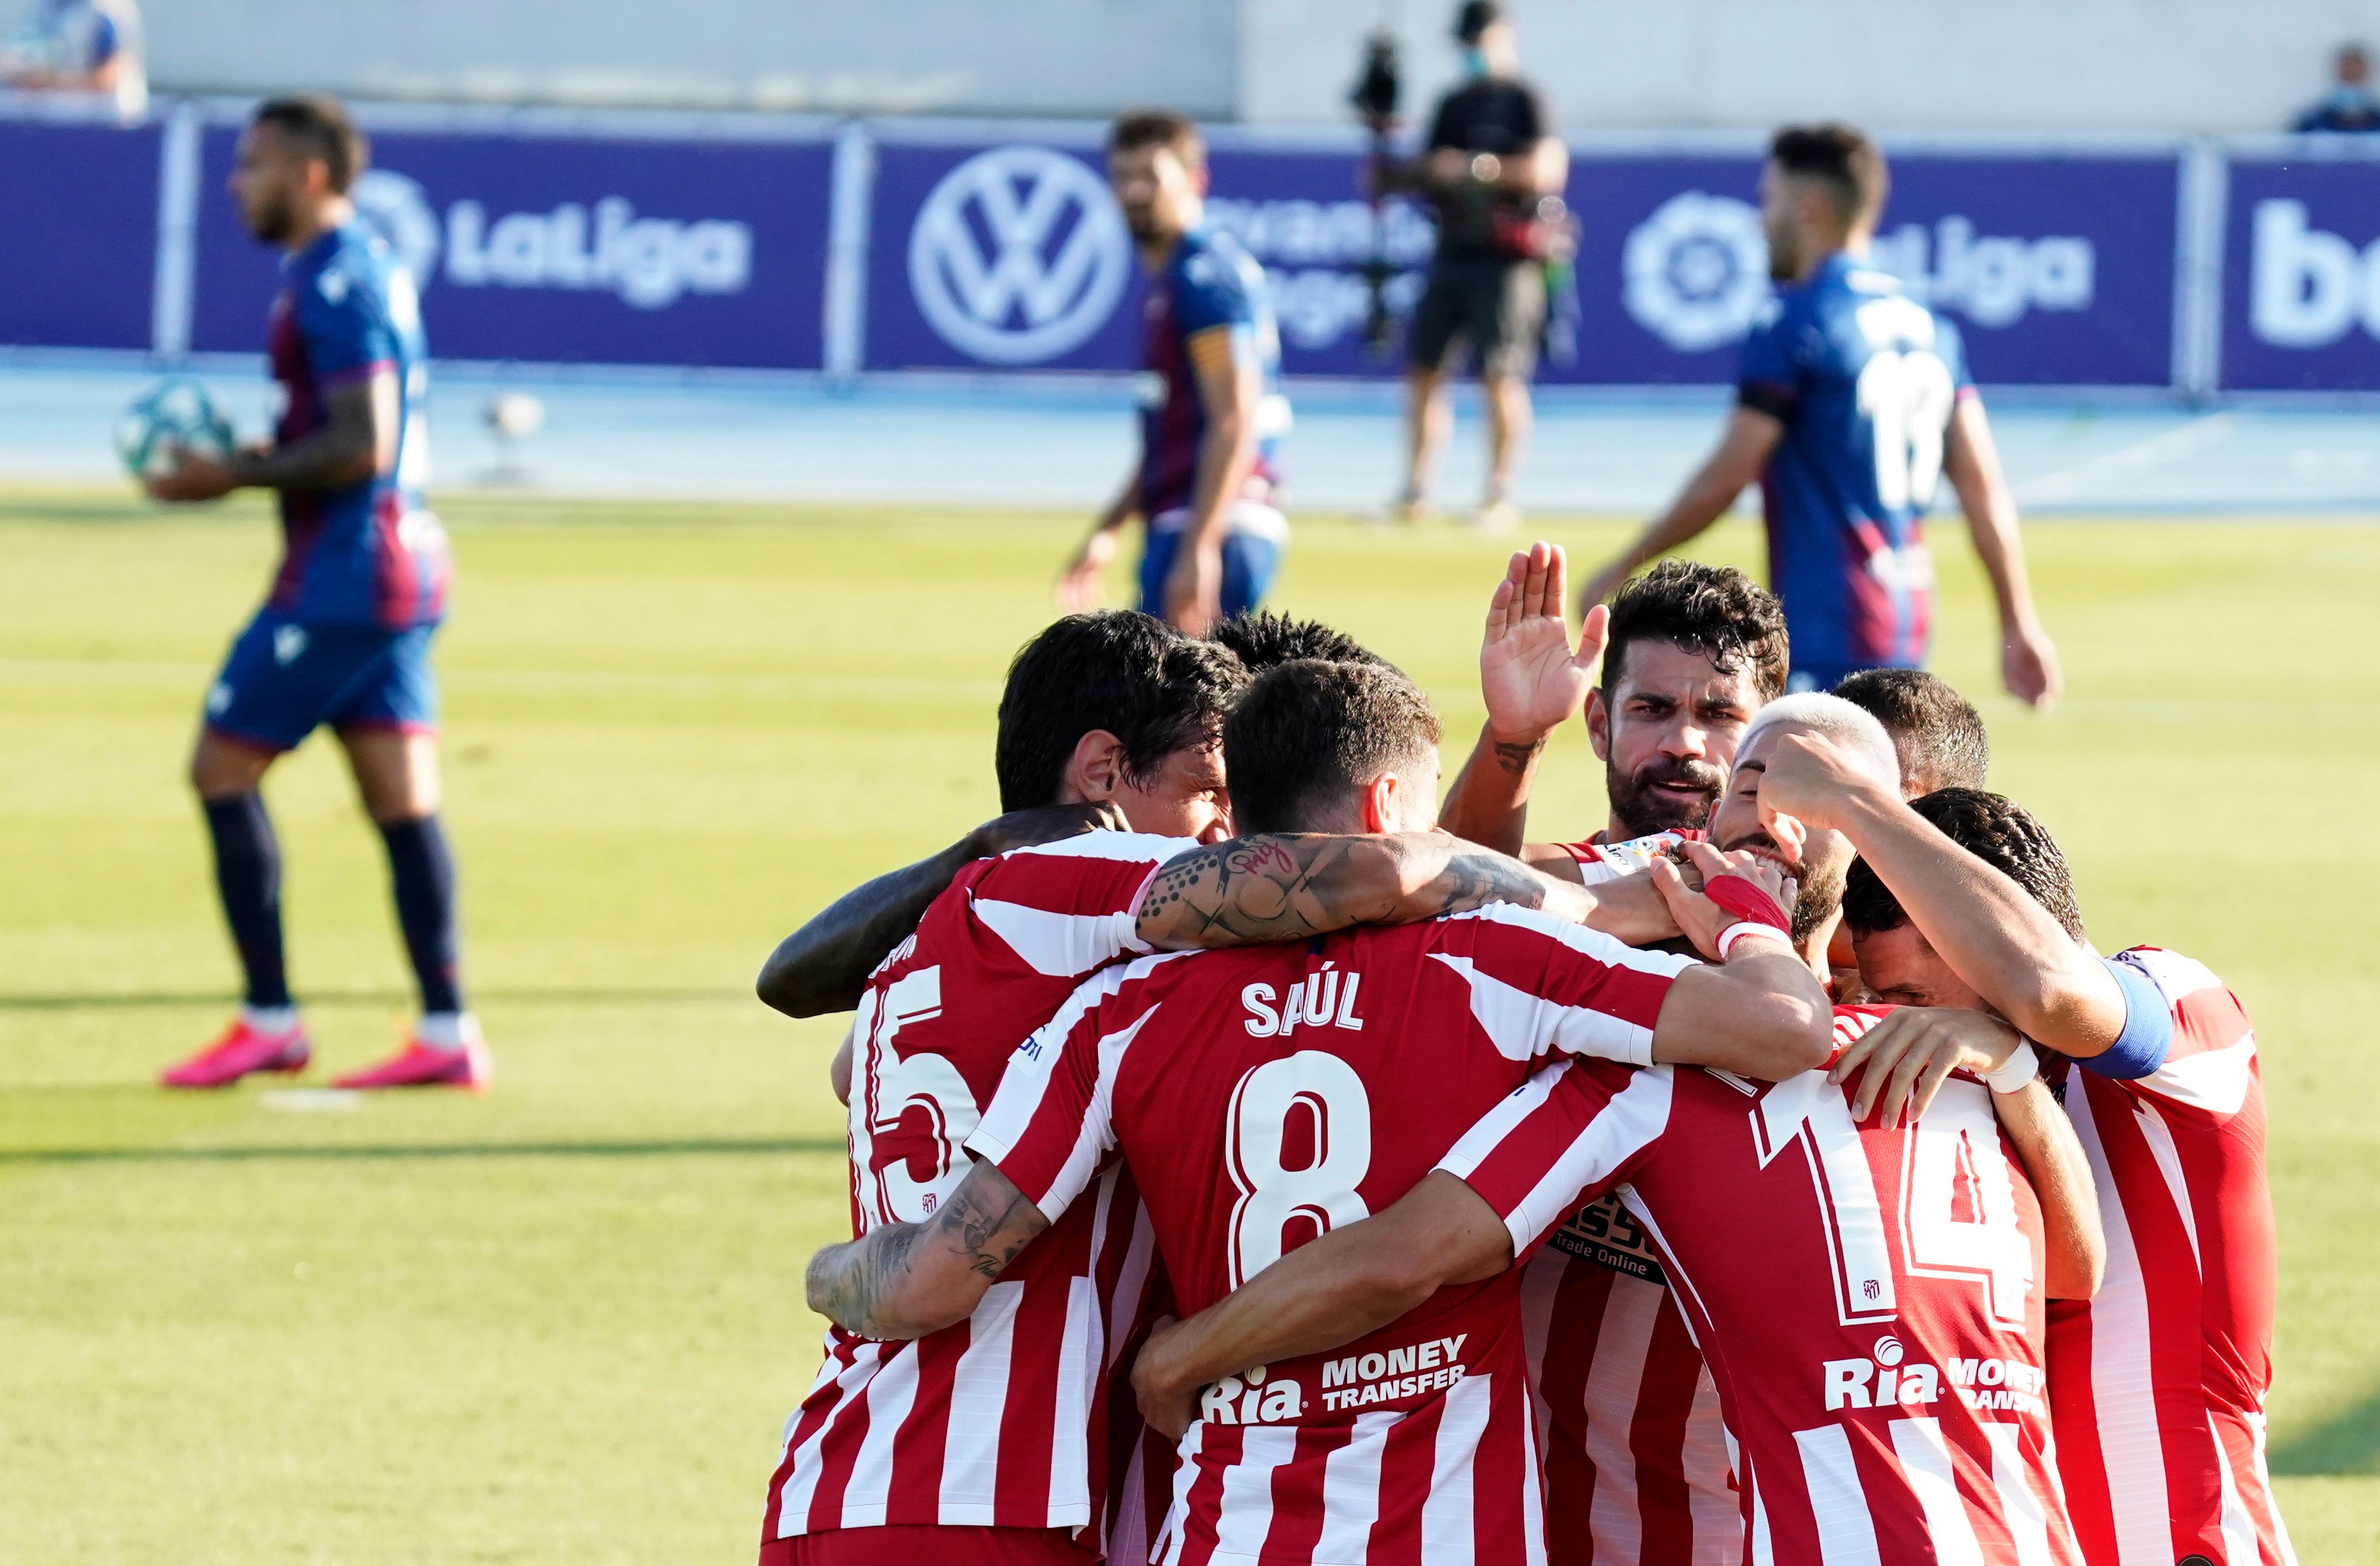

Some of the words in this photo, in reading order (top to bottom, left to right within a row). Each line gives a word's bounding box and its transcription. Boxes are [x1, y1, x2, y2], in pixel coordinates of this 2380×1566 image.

[445, 195, 752, 310] LaLiga
[1866, 215, 2095, 329] Liga
[1242, 961, 1363, 1038] SAÚL
[848, 964, 982, 1232] 15
[1226, 1050, 1371, 1293] 8
[1749, 1068, 2033, 1334] 14
[1557, 1232, 1592, 1258] Trade
[1597, 1248, 1647, 1275] Online
[1202, 1365, 1302, 1425] Ria
[1322, 1333, 1468, 1388] MONEY
[1322, 1364, 1466, 1411] TRANSFER
[1823, 1335, 1939, 1411] Ria
[1948, 1357, 2046, 1396] MONEY
